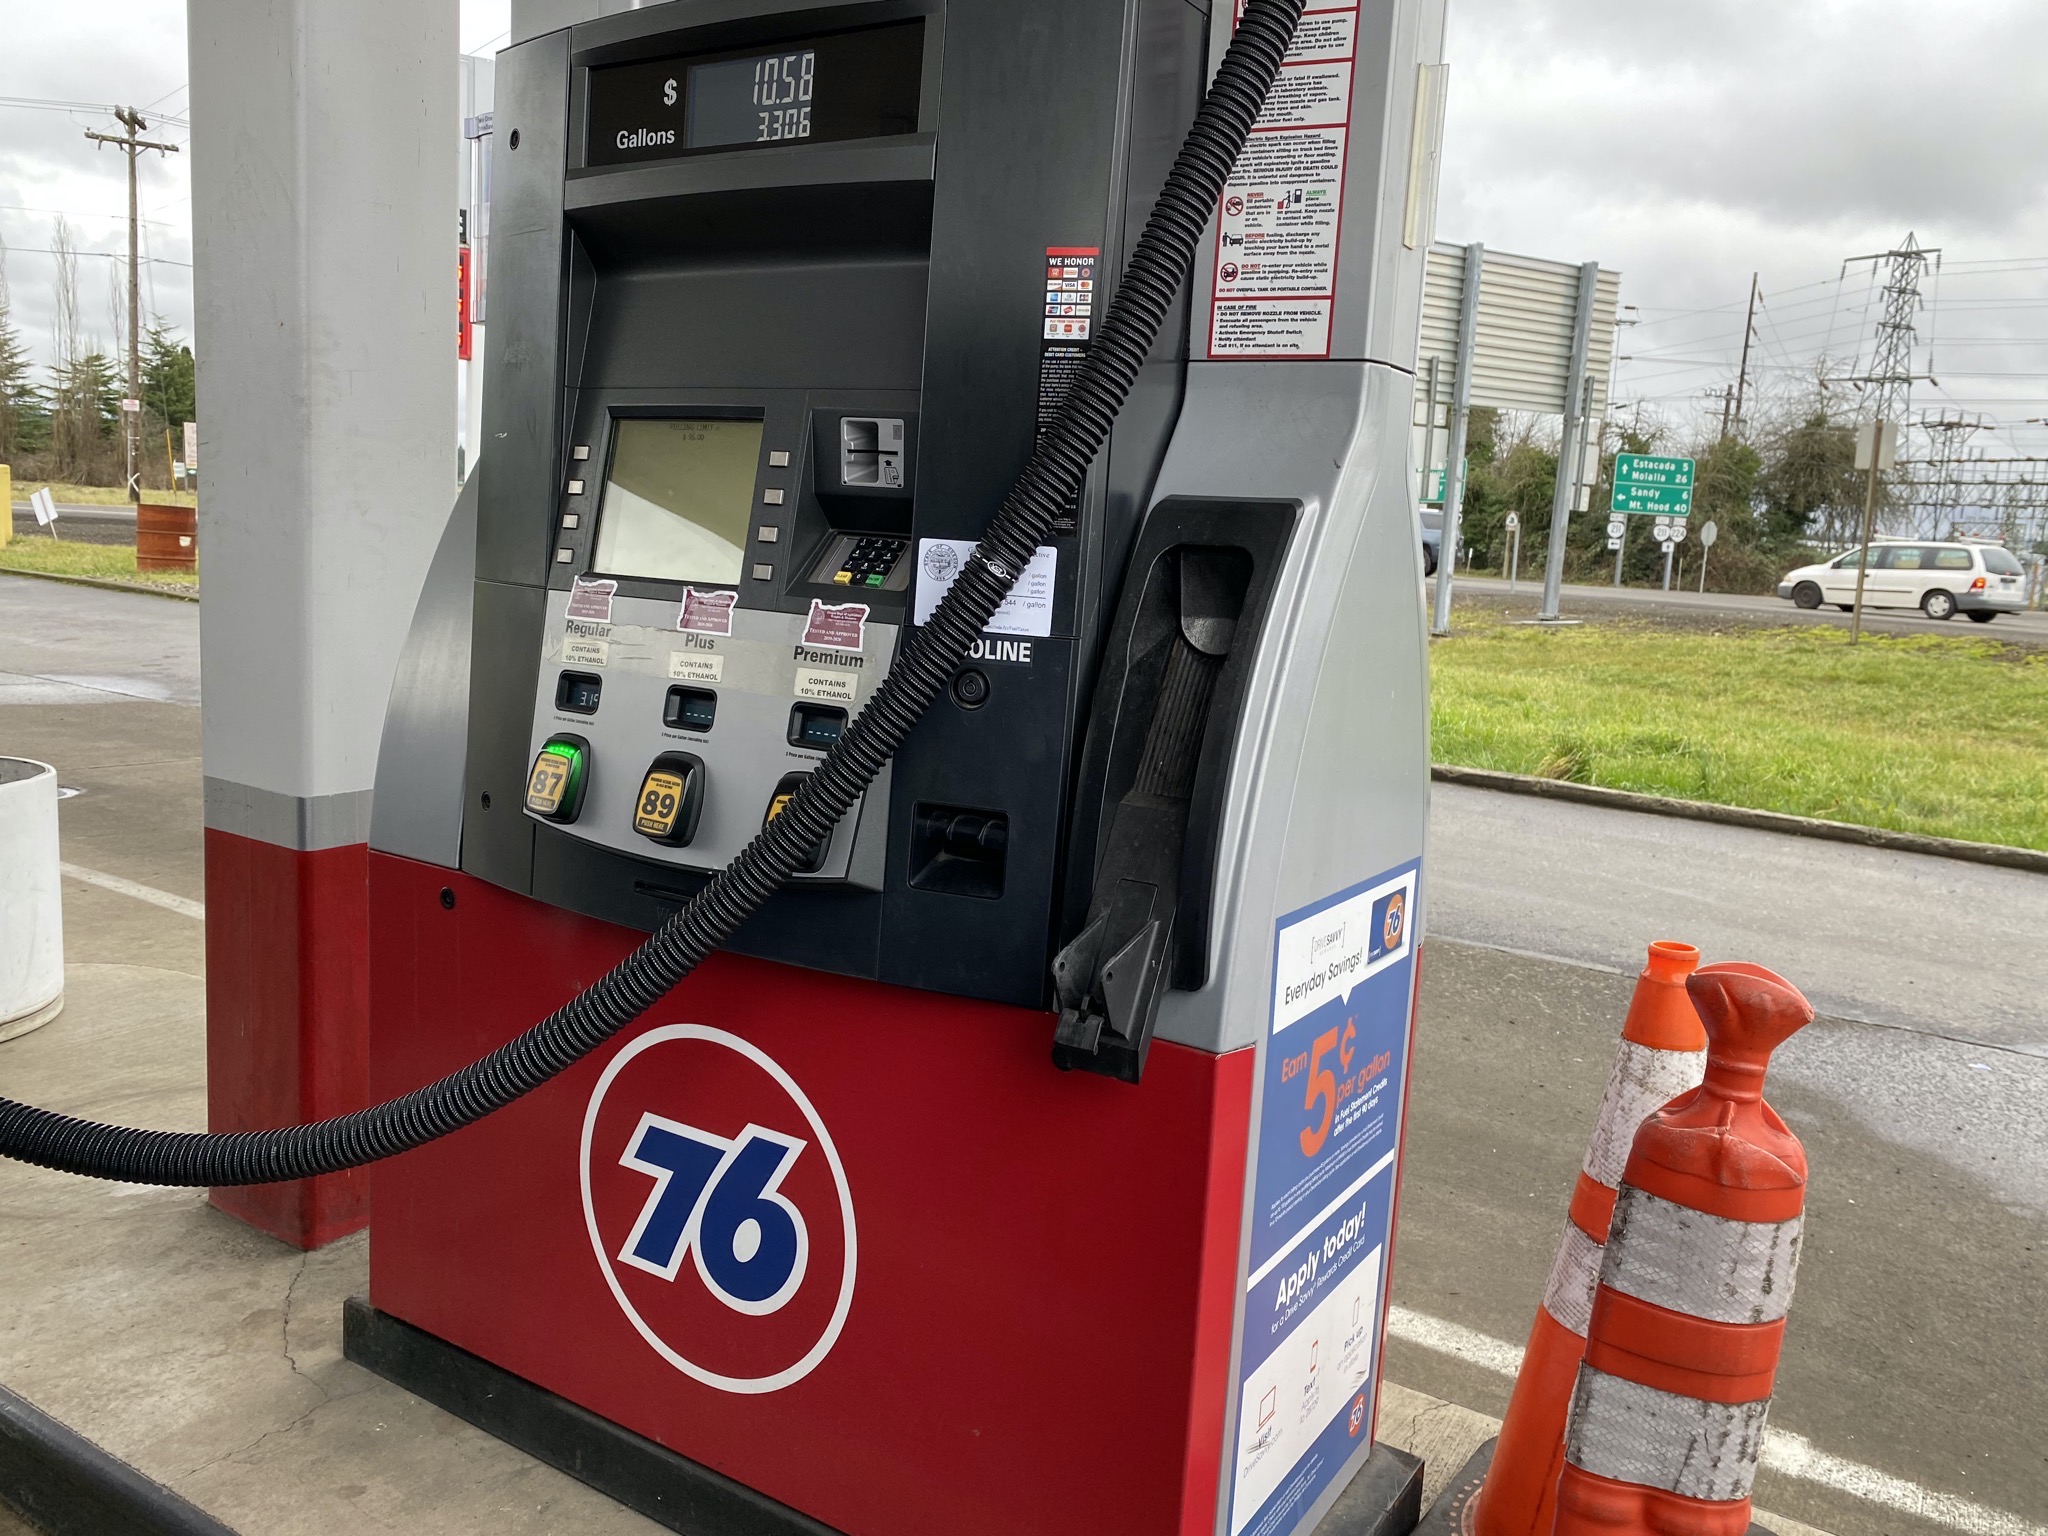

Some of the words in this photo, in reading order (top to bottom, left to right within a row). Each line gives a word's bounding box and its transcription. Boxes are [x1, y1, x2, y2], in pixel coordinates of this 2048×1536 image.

[663, 78, 677, 106] $
[752, 52, 814, 106] 10.58
[617, 129, 675, 148] Gallons
[757, 107, 811, 142] 3.306
[1633, 459, 1675, 471] Estacada
[1683, 463, 1688, 471] 5
[1632, 471, 1666, 482] Molalla
[1675, 474, 1687, 483] 26
[1631, 487, 1660, 499] Sandy
[1682, 491, 1688, 499] 6
[1629, 501, 1642, 510] Mt.
[1647, 502, 1669, 511] Hood
[1674, 504, 1687, 512] 40
[566, 620, 611, 638] Regular
[685, 633, 715, 649] Plus
[965, 639, 1031, 662] OLINE
[680, 661, 713, 669] CONTAINS
[794, 646, 863, 668] Premium
[688, 672, 718, 680] ETHANOL
[808, 678, 846, 687] CONTAINS
[817, 690, 852, 699] ETHANOL
[533, 770, 562, 796] 87
[642, 790, 675, 818] 89
[1386, 903, 1401, 939] 76
[1285, 971, 1326, 1005] Everyday
[1329, 947, 1362, 981] Savings!
[1282, 1051, 1307, 1083] Earn
[1336, 1076, 1354, 1108] per
[1358, 1051, 1390, 1093] gallon
[1340, 1105, 1350, 1120] Fuel
[1350, 1088, 1372, 1112] Statement
[1373, 1078, 1387, 1094] Credits
[1334, 1123, 1344, 1136] after
[1368, 1096, 1378, 1109] days
[617, 1111, 808, 1316] 76
[1275, 1250, 1320, 1311] Apply
[1323, 1201, 1366, 1264] today!
[1285, 1303, 1298, 1321] Drive
[1317, 1263, 1337, 1288] Rewards
[1338, 1246, 1352, 1267] Credit
[1353, 1234, 1365, 1252] Card
[1304, 1377, 1315, 1396] Text
[1259, 1425, 1271, 1448] Visit
